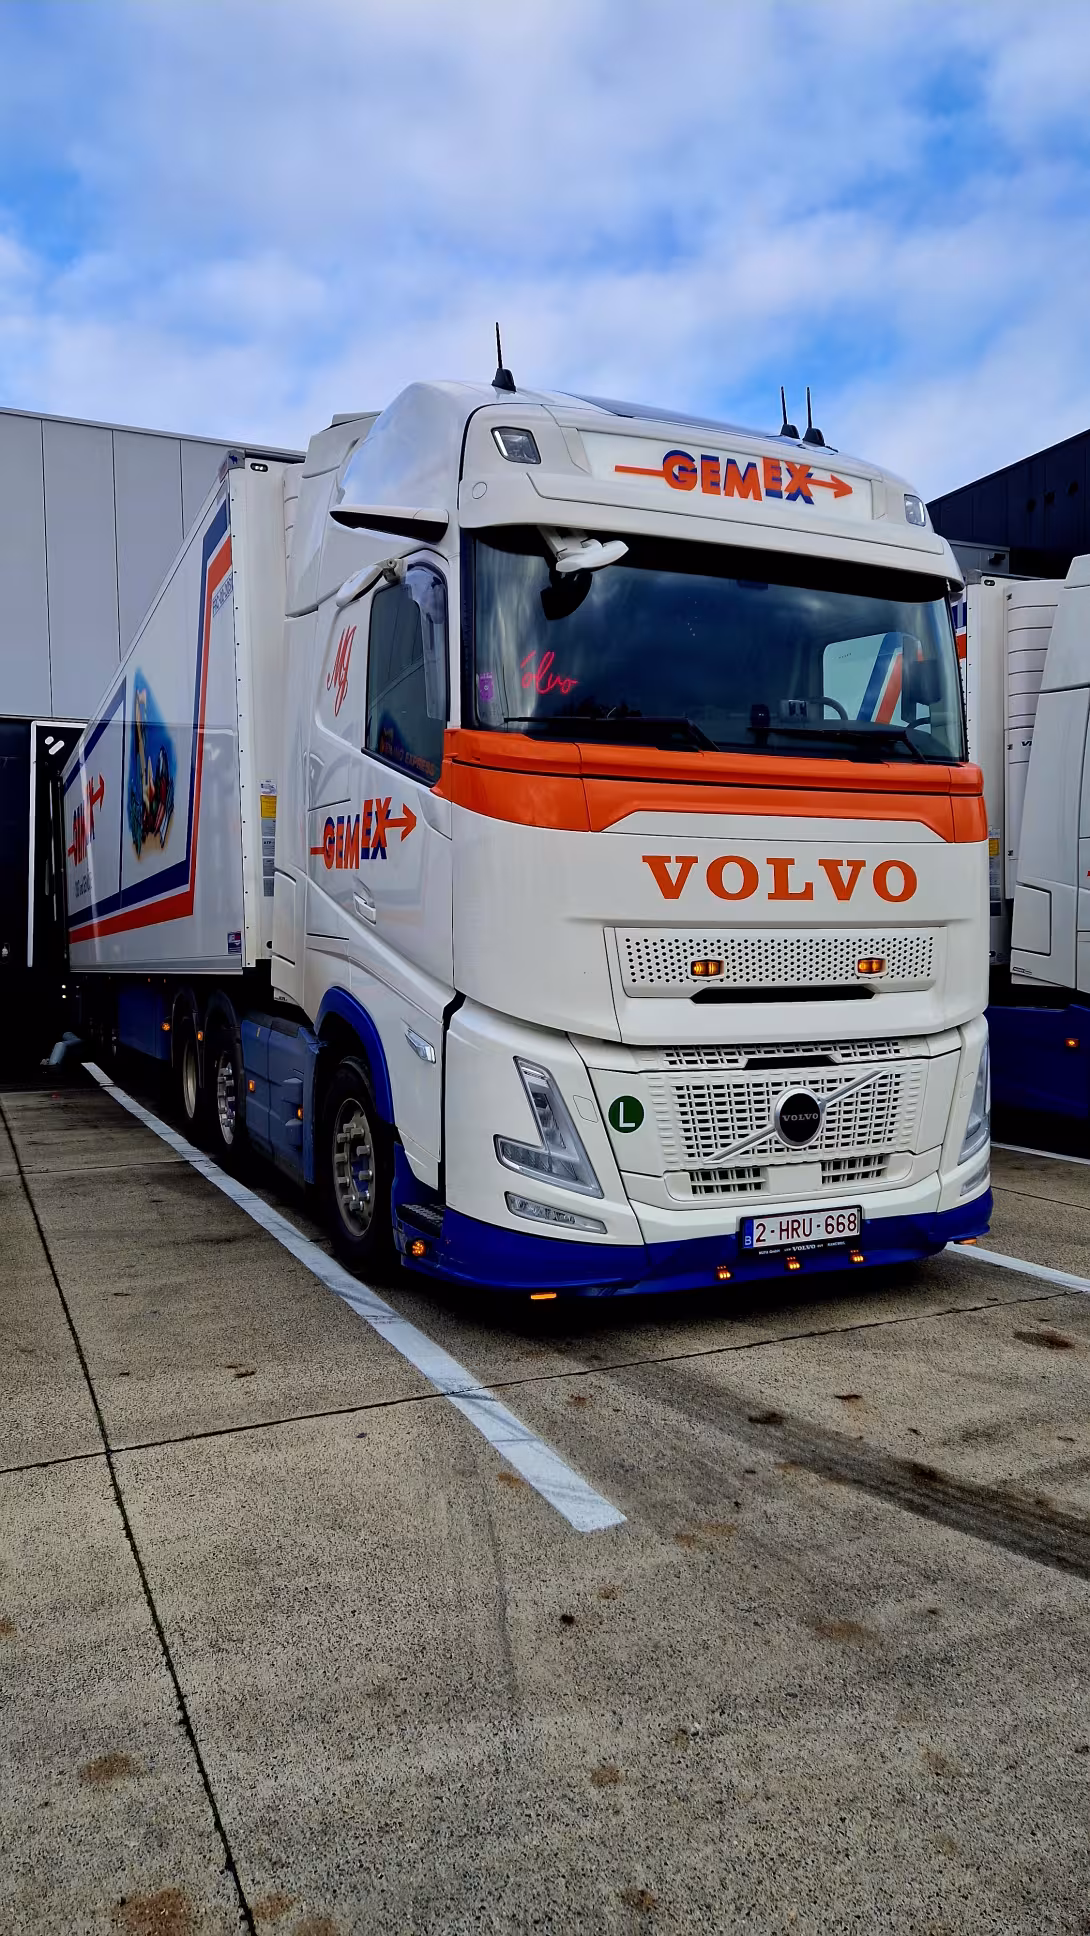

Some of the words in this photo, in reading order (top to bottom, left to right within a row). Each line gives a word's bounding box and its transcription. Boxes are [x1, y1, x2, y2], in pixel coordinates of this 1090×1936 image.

[663, 449, 815, 505] GEMEX
[323, 797, 391, 870] GEMEX
[642, 855, 918, 903] VOLVO
[619, 1101, 636, 1128] L
[782, 1112, 819, 1122] VOLVO
[744, 1235, 752, 1246] B
[792, 1244, 816, 1252] VOLVO
